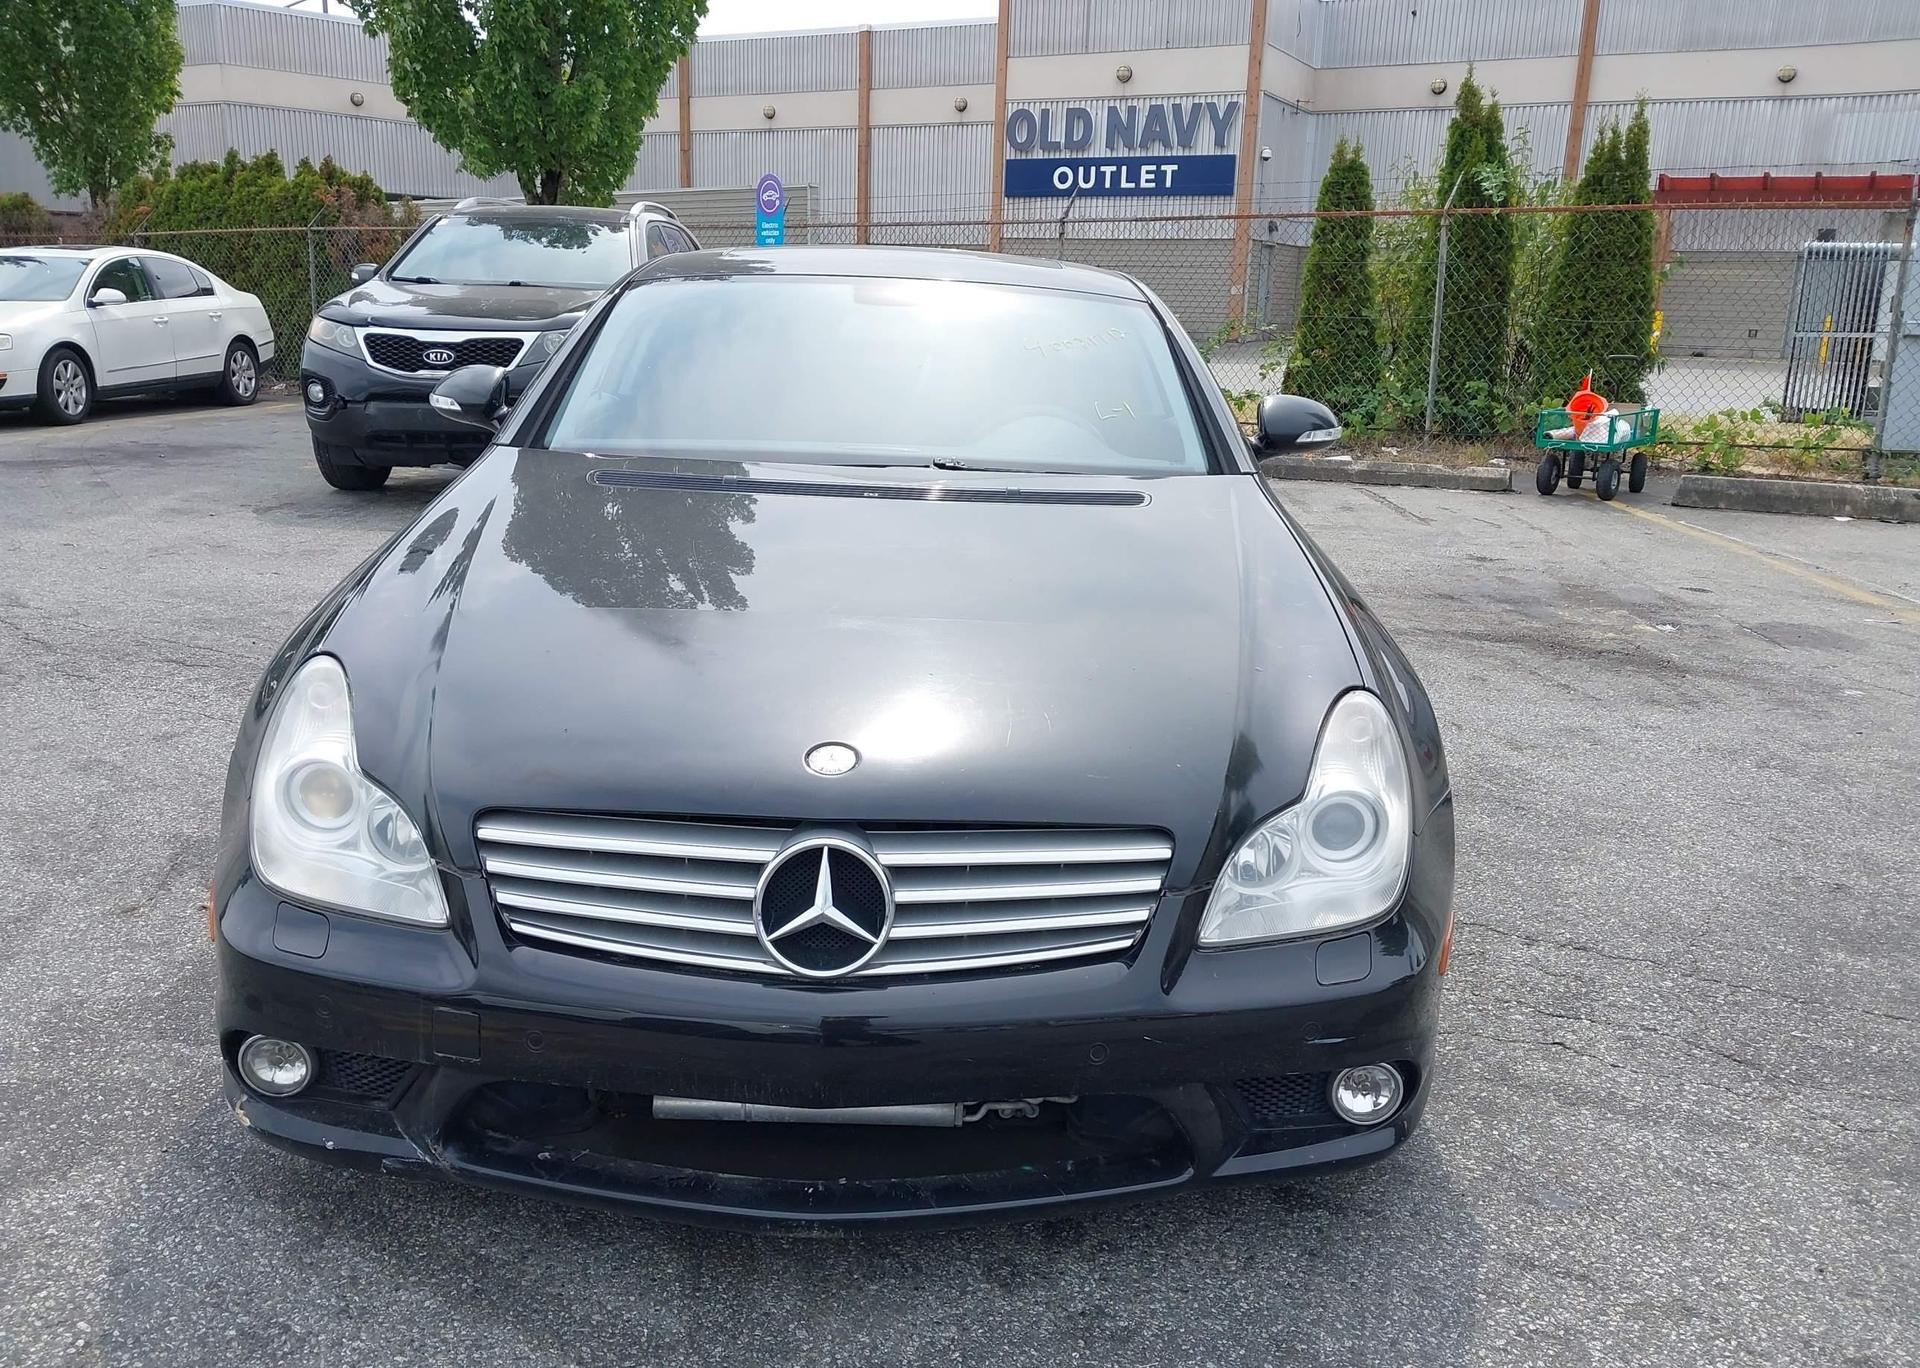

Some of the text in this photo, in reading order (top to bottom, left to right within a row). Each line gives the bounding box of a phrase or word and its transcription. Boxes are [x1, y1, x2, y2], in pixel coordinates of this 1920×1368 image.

[1007, 101, 1240, 151] OLD NAVY
[1052, 164, 1179, 190] OUTLET
[429, 352, 448, 361] KIA
